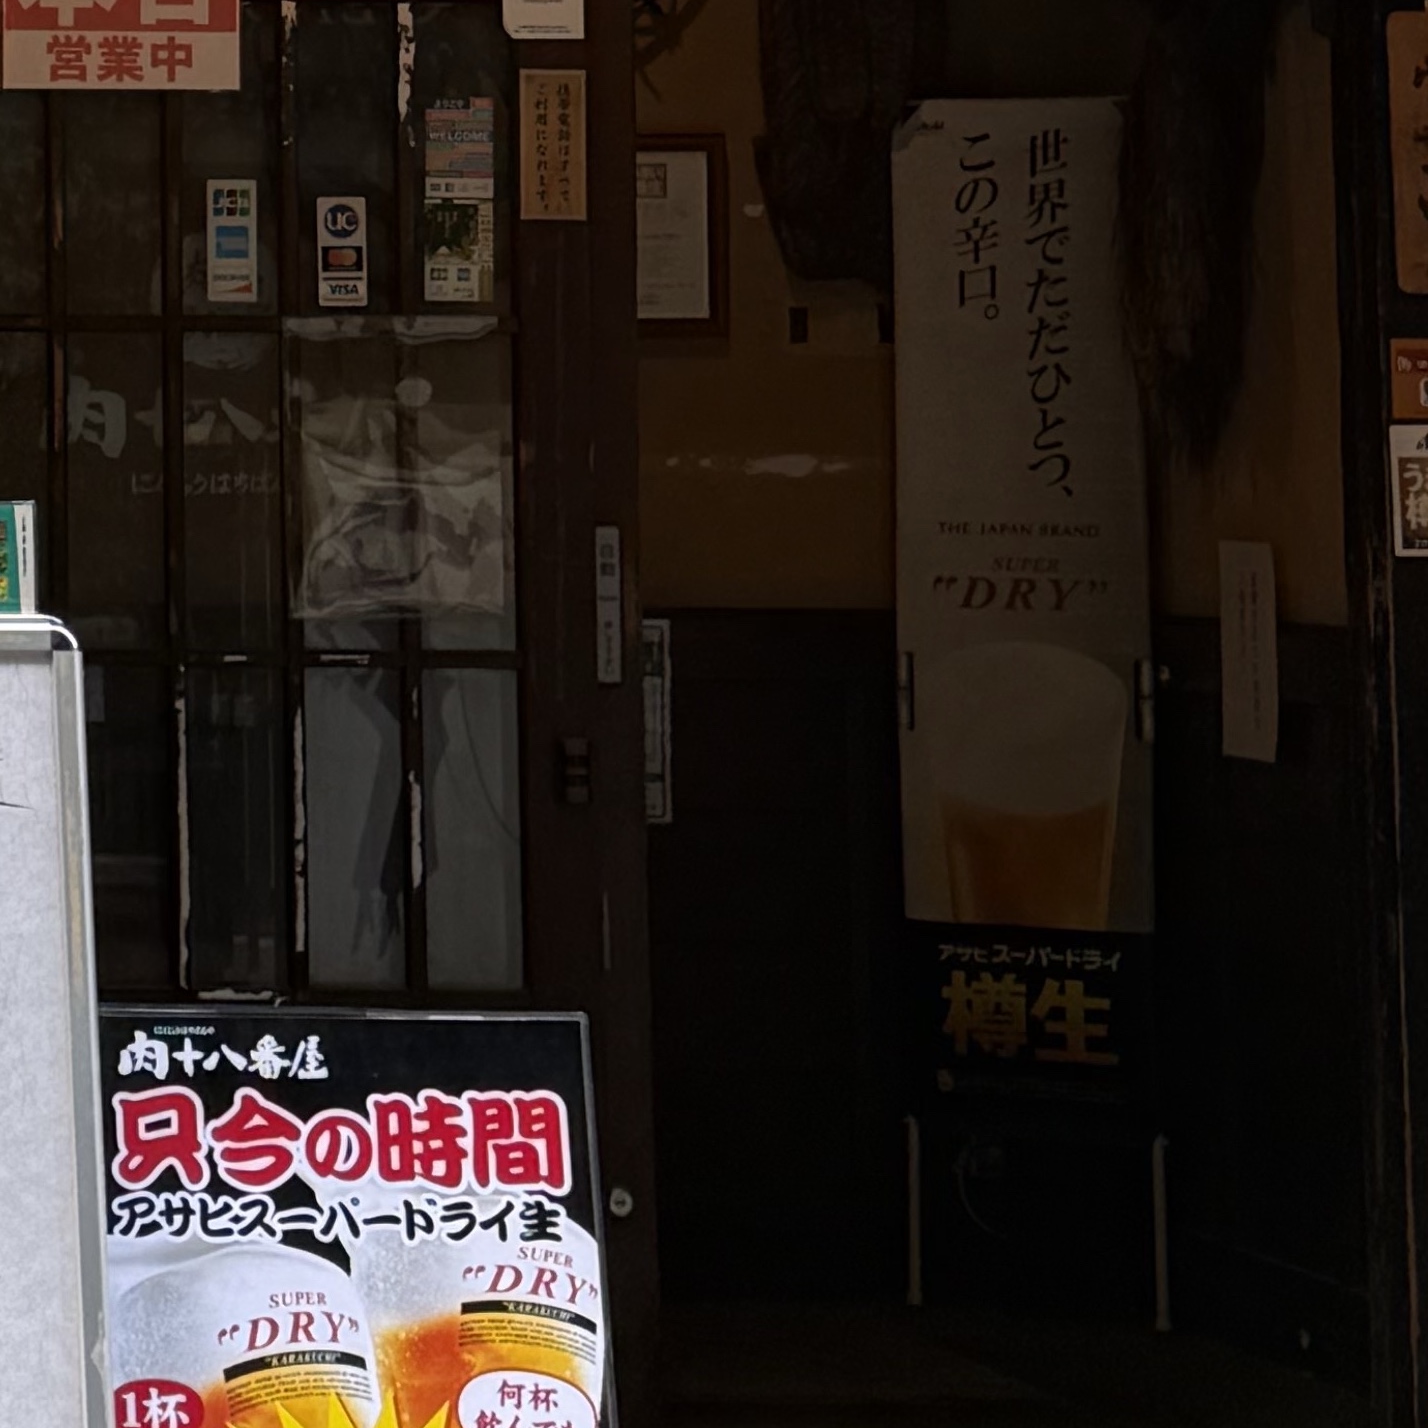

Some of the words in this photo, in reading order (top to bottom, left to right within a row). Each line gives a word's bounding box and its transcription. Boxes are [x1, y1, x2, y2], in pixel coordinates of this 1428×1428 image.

[46, 35, 194, 83] 営業中
[325, 210, 359, 233] UC
[953, 132, 1000, 321] この辛口。
[329, 284, 360, 296] VISA
[1025, 128, 1074, 497] 世界でただひとつ、
[938, 522, 970, 535] THE
[980, 523, 1032, 537] JAPAN
[993, 556, 1060, 572] SUPER
[938, 943, 1123, 973] アサヒスーパードライ
[940, 969, 1121, 1065] 樽生
[117, 1030, 330, 1081] 肉十八番屋
[116, 1089, 569, 1192] 只今の時間
[116, 1195, 567, 1242] アサヒスーパードライ生
[517, 1246, 574, 1269] SUPER
[269, 1291, 328, 1309] SUPER
[497, 1378, 560, 1412] 何杯
